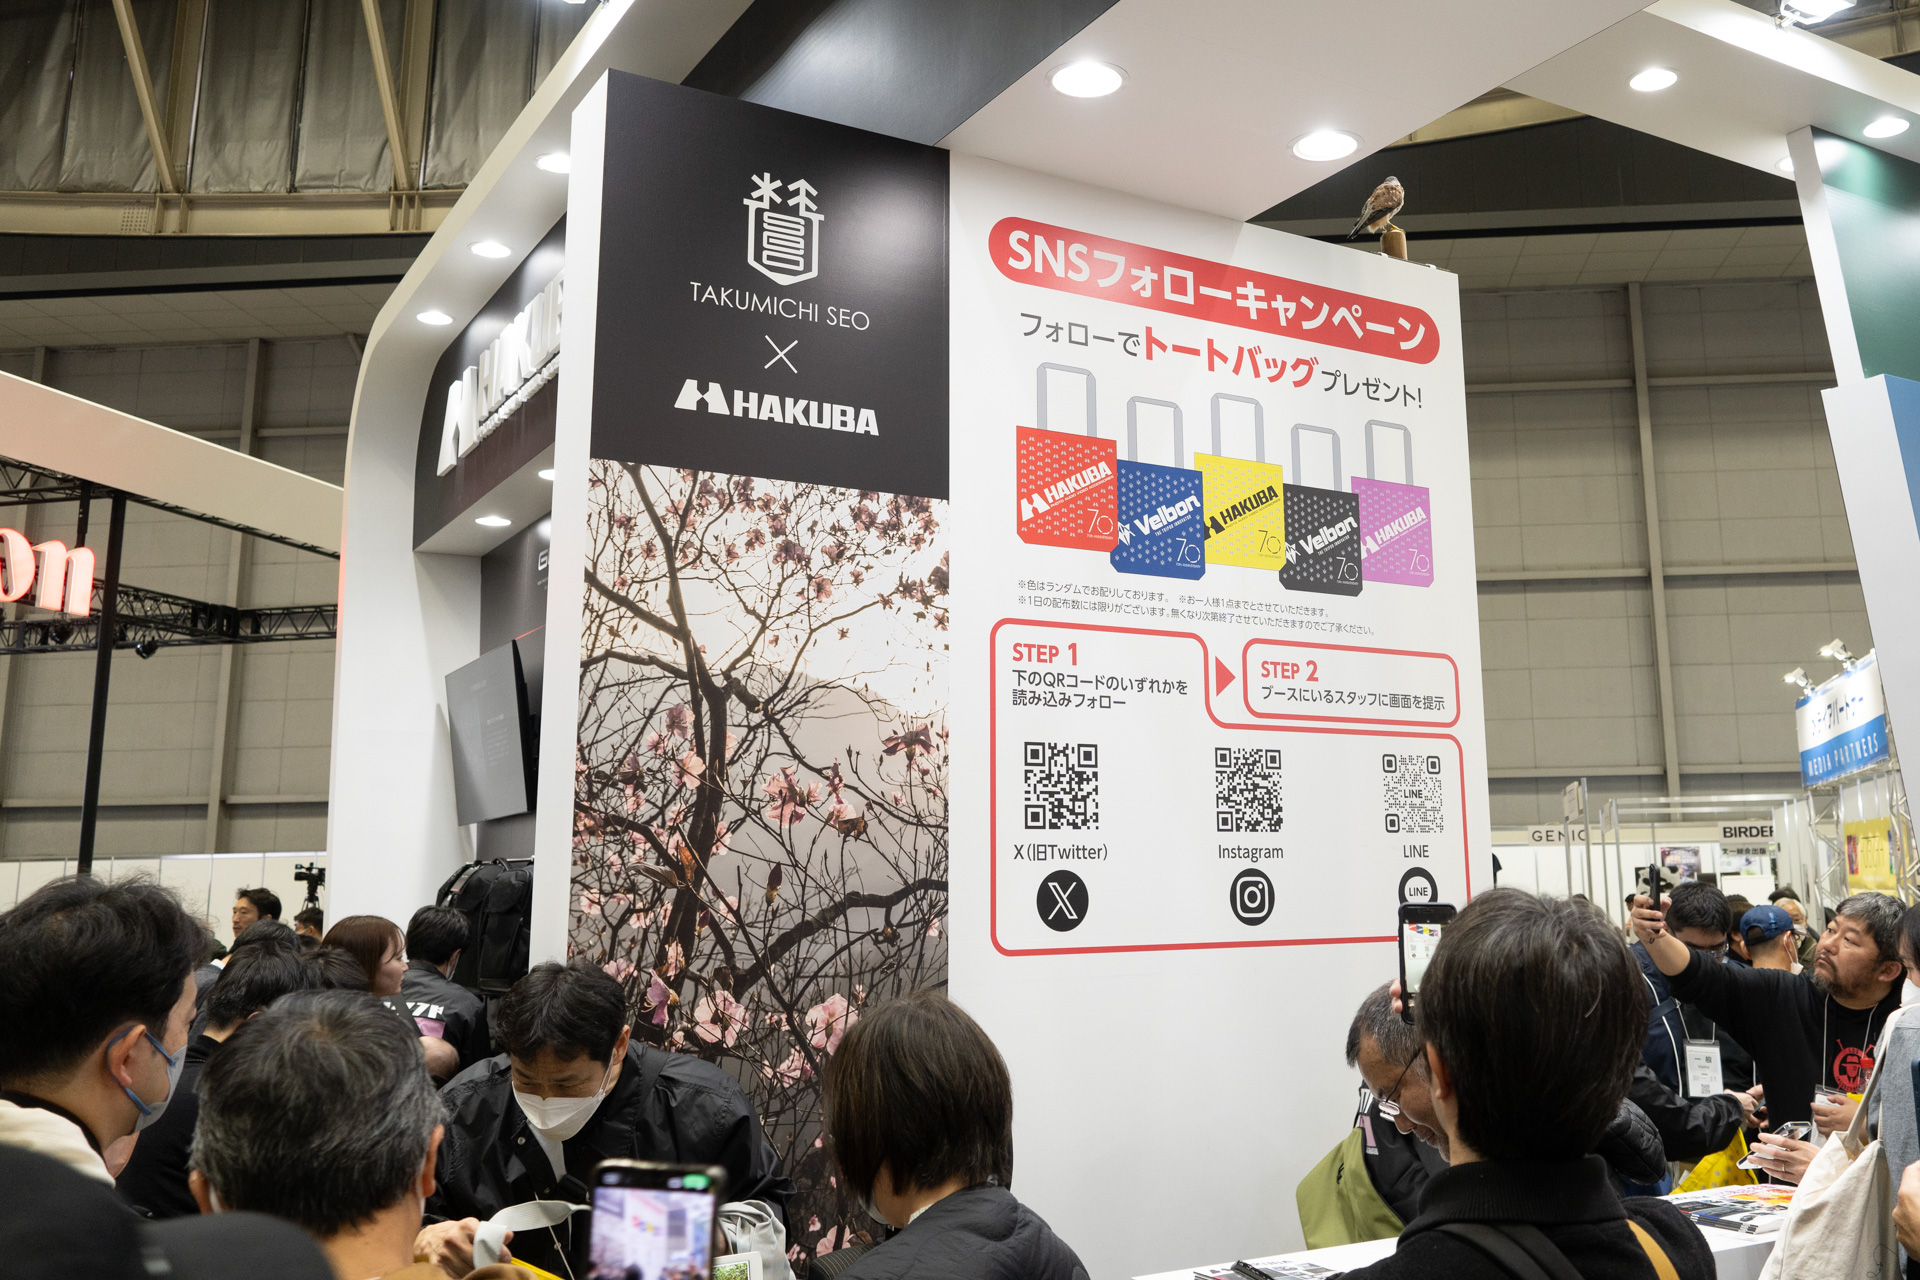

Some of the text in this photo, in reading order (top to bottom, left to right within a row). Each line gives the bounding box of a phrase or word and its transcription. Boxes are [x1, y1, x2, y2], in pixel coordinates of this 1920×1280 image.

[1007, 230, 1426, 350] SNSフォローキャンペーン
[690, 282, 870, 331] TAKUMICHI SEO
[733, 389, 879, 436] HAKUBA
[1043, 460, 1113, 504] HAKUBA
[1133, 495, 1201, 536] Velbon
[1219, 485, 1279, 525] HAKUBA
[1087, 508, 1114, 535] 70
[1374, 506, 1427, 545] HAKUBA
[1258, 529, 1281, 555] 70
[1298, 516, 1358, 555] Velbon
[1175, 537, 1201, 564] 70
[1408, 548, 1430, 572] 70
[1336, 556, 1359, 581] 70
[1012, 642, 1078, 666] STEP 1
[1012, 669, 1188, 695] 下のQRコードのいずれかを
[1260, 659, 1319, 682] STEP 2
[1012, 688, 1127, 709] 読み込みフォロー
[1261, 685, 1446, 711] ブースにいるスタッフに画面を提示
[1808, 732, 1879, 777] MEDIA PARTNERS
[1403, 789, 1423, 799] LINE
[1217, 844, 1285, 863] Instagram
[1403, 844, 1430, 858] LINE
[1408, 886, 1429, 897] LINE
